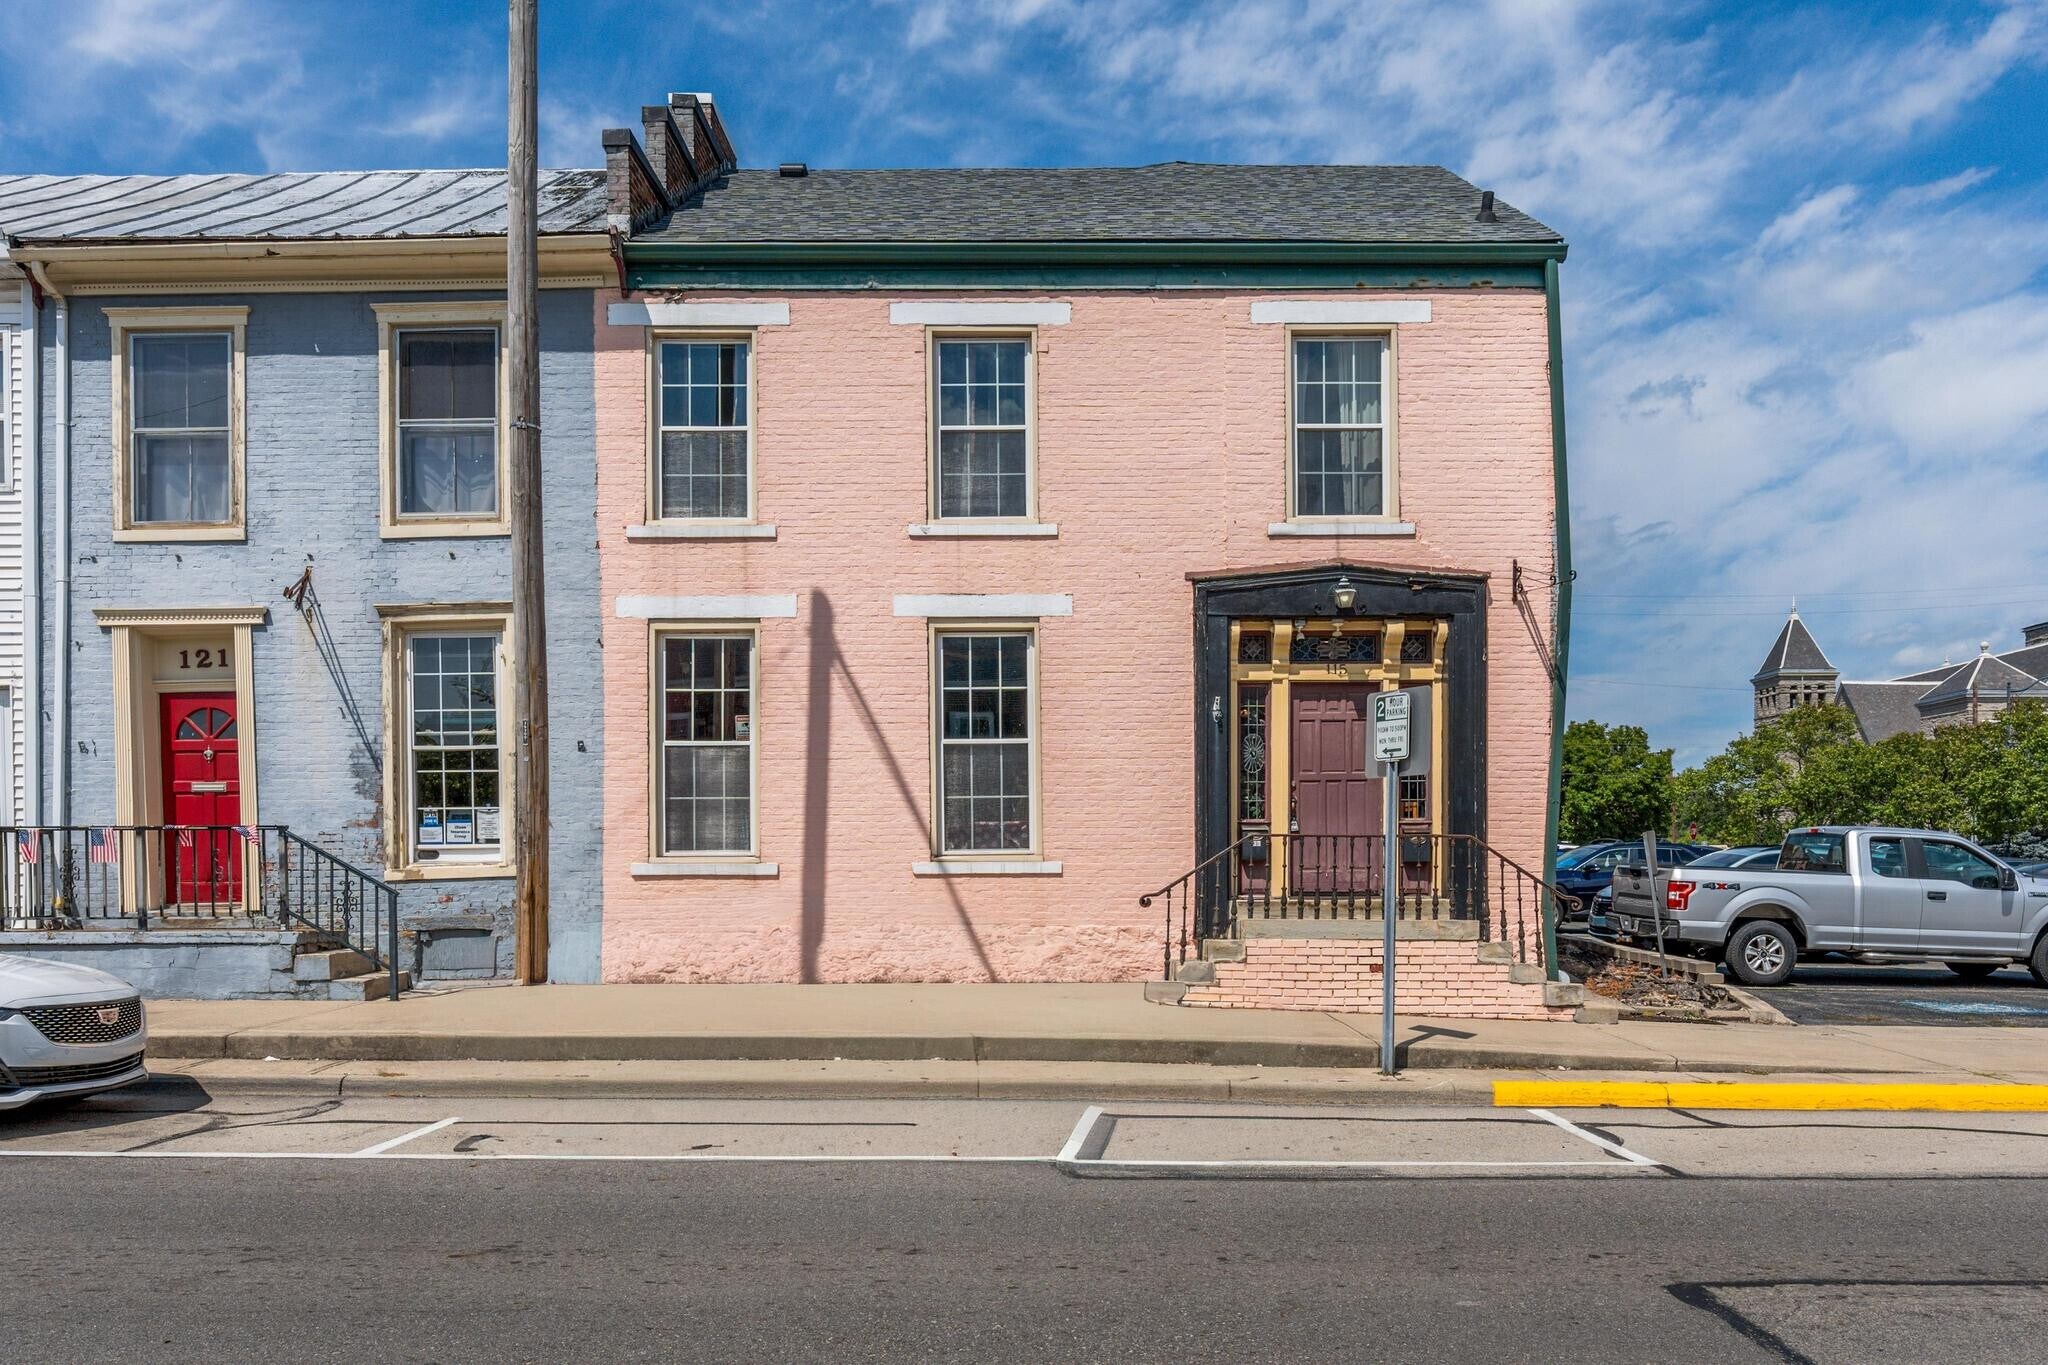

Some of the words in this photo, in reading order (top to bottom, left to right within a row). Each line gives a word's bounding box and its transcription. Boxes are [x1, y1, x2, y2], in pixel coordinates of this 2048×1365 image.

[179, 648, 229, 669] 121
[1327, 662, 1348, 675] 115
[1389, 697, 1404, 707] HOUR
[1377, 701, 1385, 717] 2
[1386, 707, 1407, 717] PARKING
